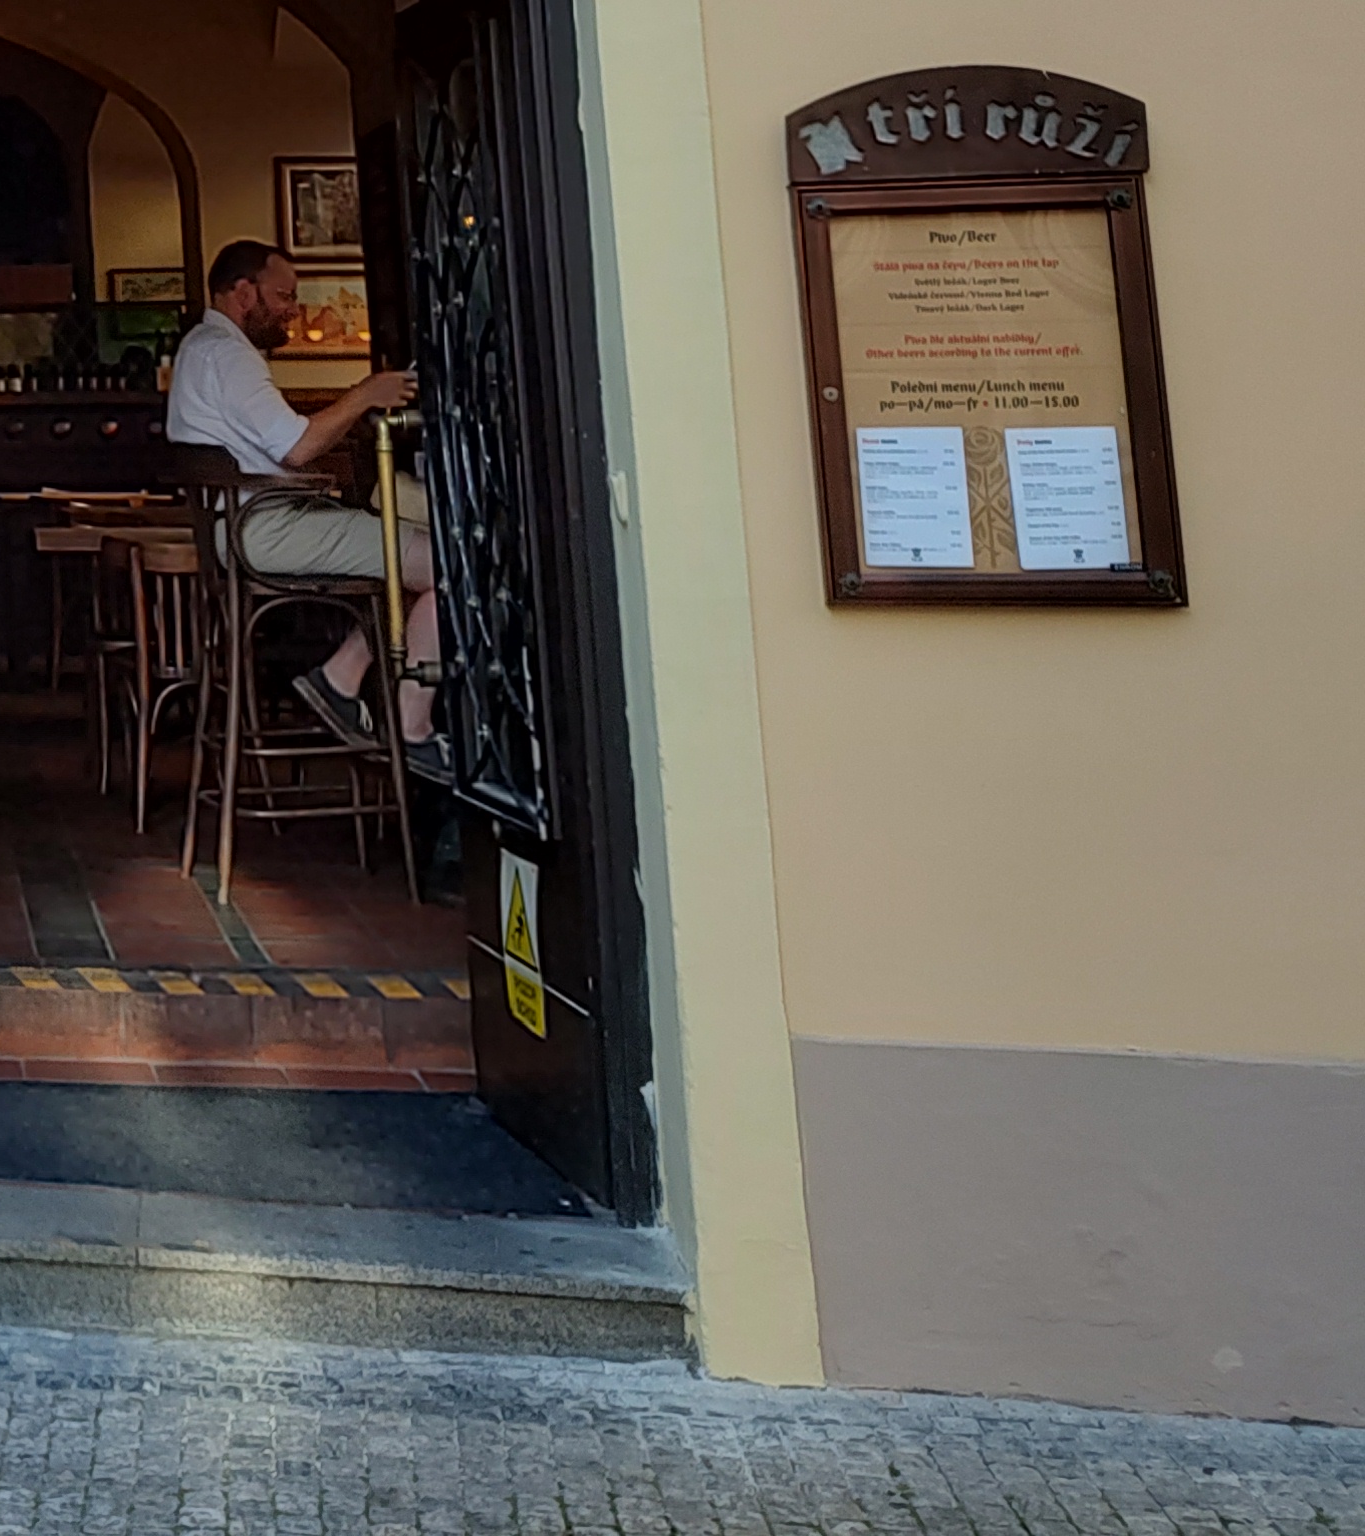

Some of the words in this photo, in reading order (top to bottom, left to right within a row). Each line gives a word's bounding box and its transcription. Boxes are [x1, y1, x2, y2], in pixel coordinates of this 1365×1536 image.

[866, 84, 967, 145] tří
[984, 93, 1140, 167] růží
[928, 230, 997, 246] Pivo/Beer
[941, 379, 1026, 395] menu/Lunch
[1029, 381, 1065, 393] menu
